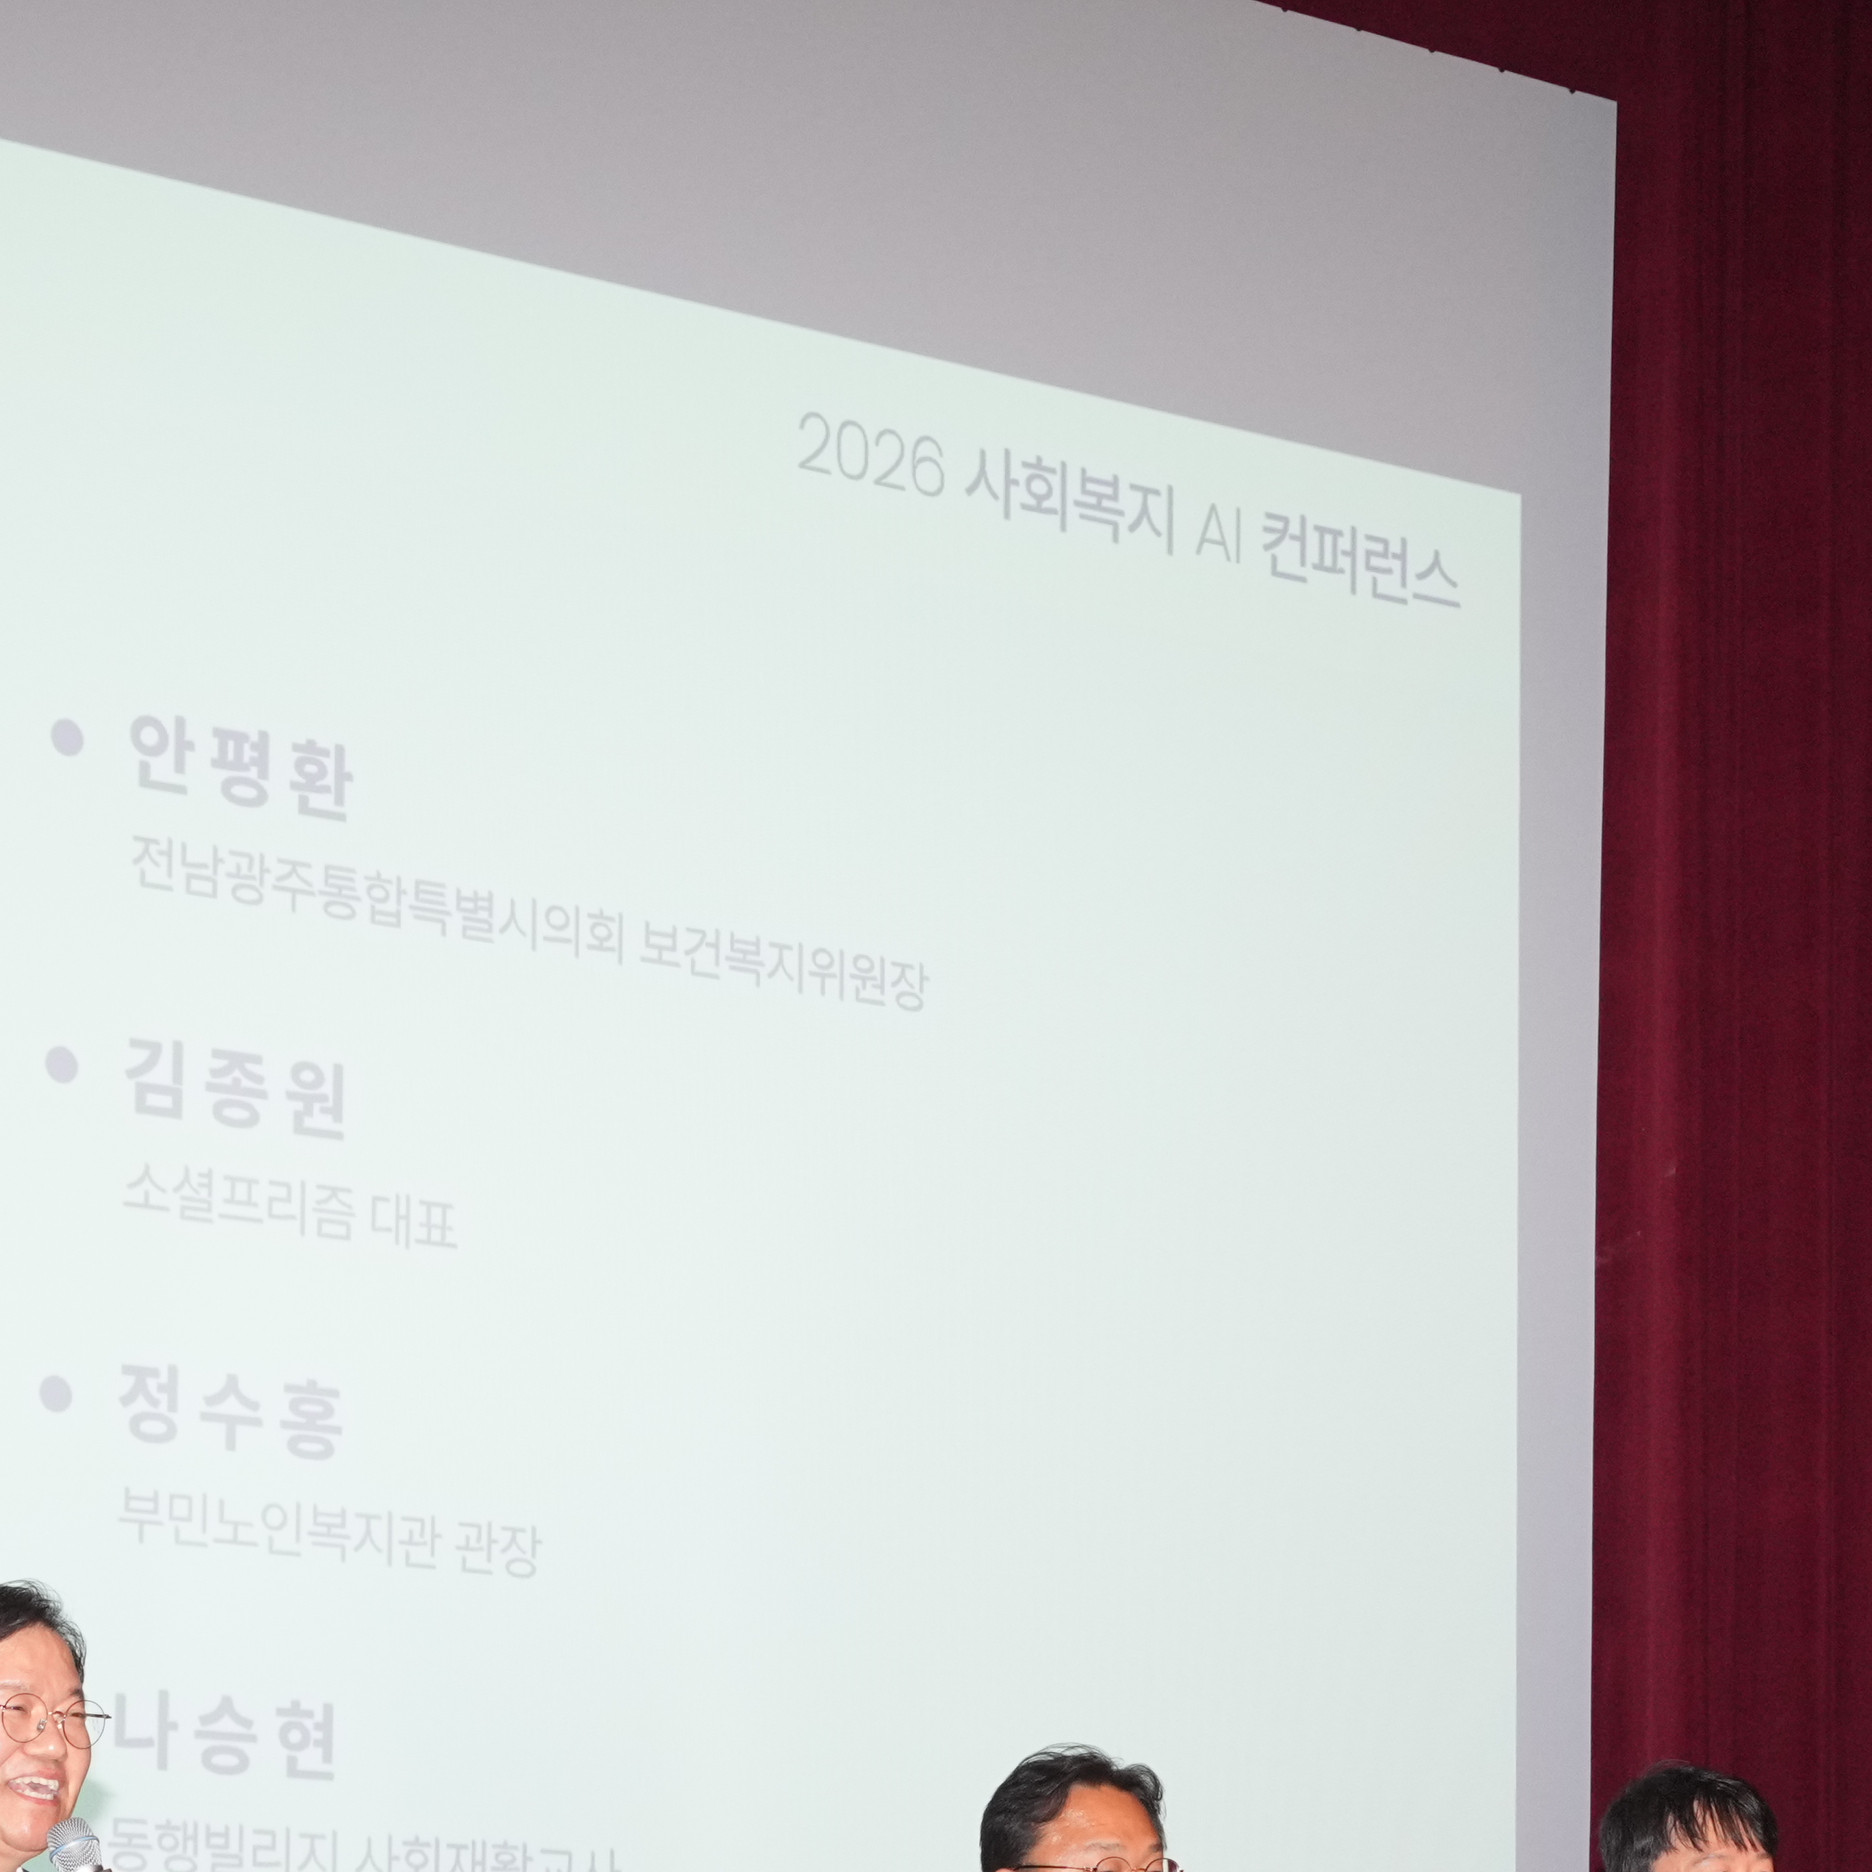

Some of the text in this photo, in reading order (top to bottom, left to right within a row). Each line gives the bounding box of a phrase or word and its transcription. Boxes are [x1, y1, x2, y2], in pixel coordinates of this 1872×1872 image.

[797, 411, 1462, 609] 2026 사회복지 AI 컨퍼런스
[130, 713, 355, 822] 안평환
[130, 834, 931, 1014] 전남광주통합특별시의회 보건복지위원장
[125, 1036, 346, 1142] 김종원
[122, 1162, 460, 1251] 소셜프리즘 대표
[117, 1363, 344, 1462] 정수홍
[118, 1485, 543, 1580] 부민노인복지관 관장
[114, 1689, 335, 1781] 나승현
